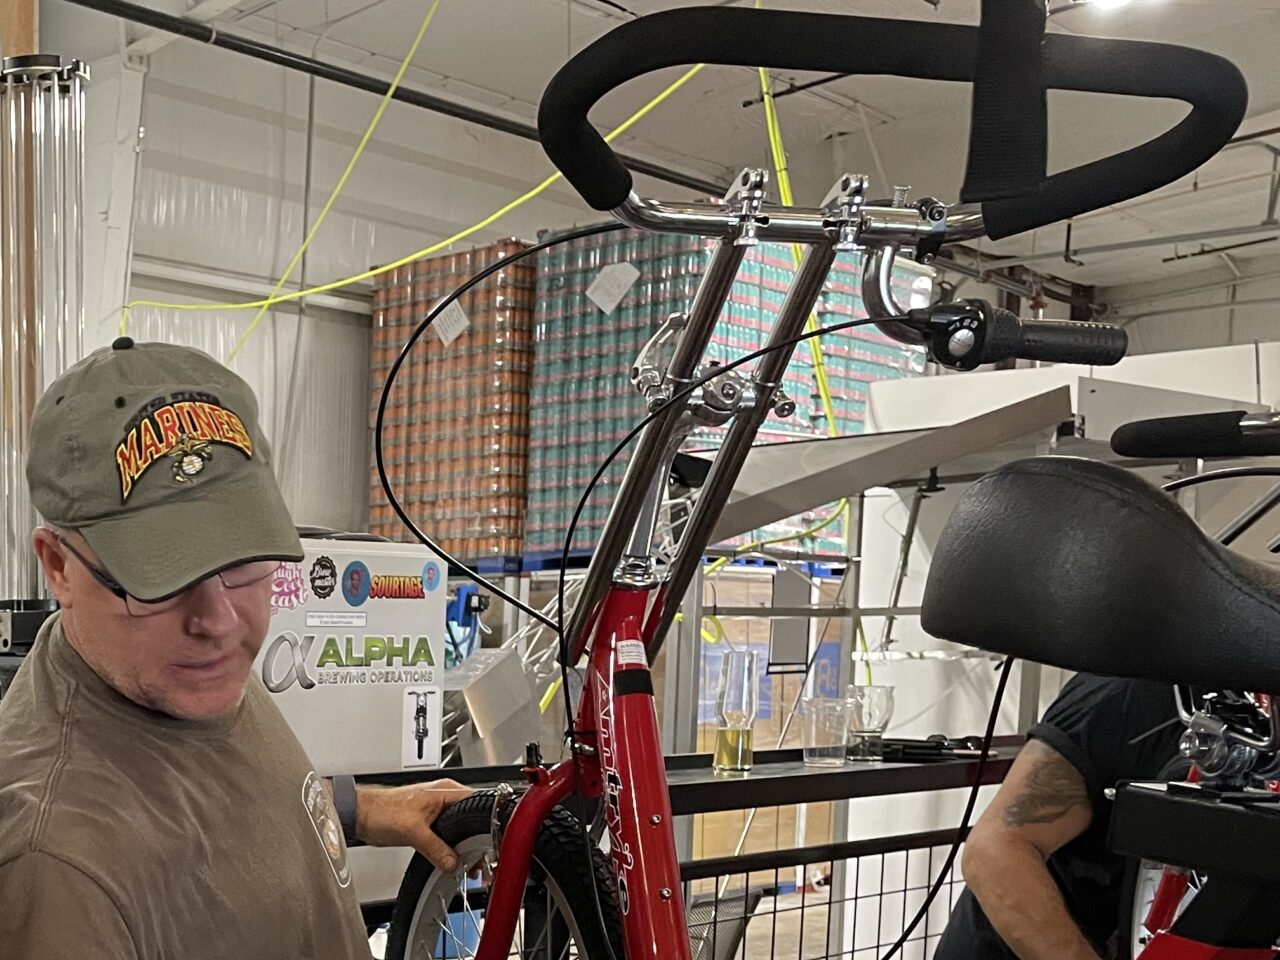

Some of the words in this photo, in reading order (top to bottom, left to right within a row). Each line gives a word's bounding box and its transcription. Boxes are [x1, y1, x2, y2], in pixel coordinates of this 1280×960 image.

[116, 401, 252, 502] MARINES
[369, 575, 425, 599] SOURTAGE
[316, 636, 435, 668] ALPHA
[317, 671, 367, 685] BREWING
[370, 670, 433, 684] OPERATIONS
